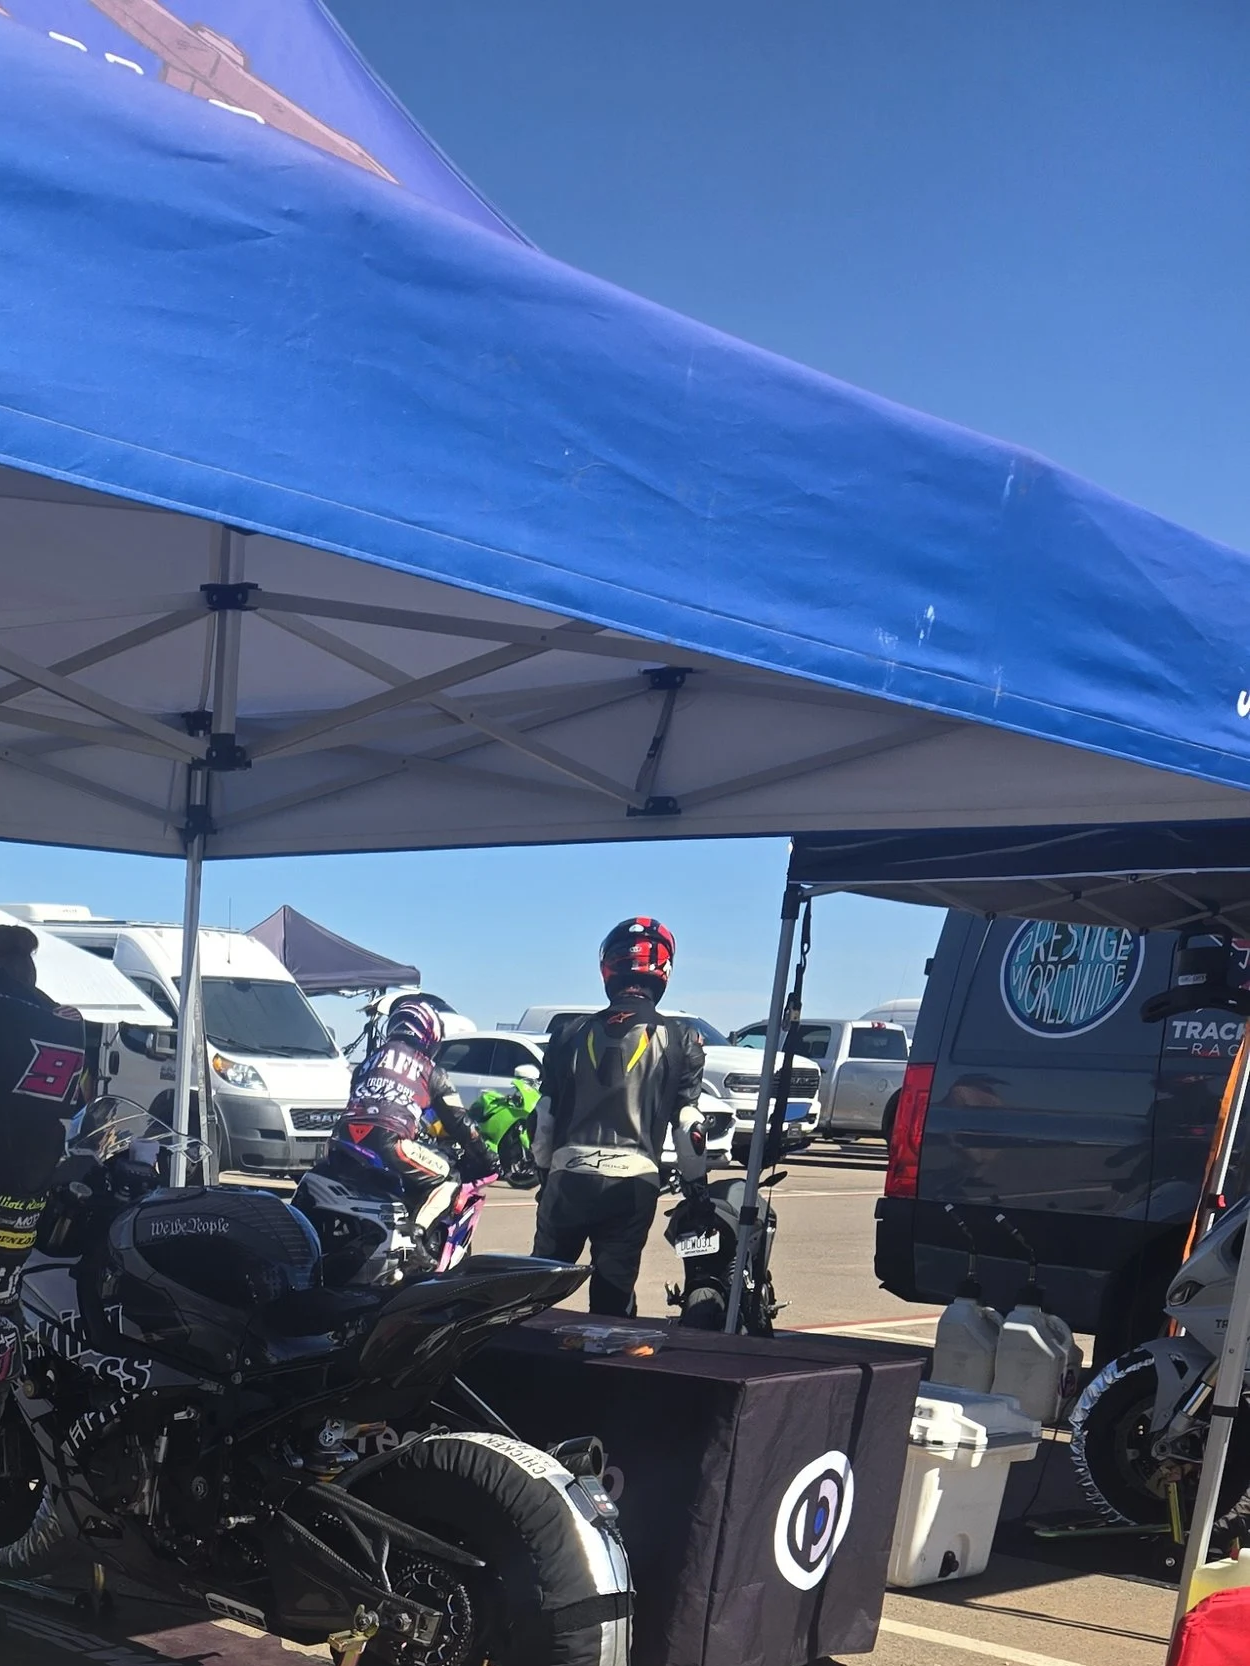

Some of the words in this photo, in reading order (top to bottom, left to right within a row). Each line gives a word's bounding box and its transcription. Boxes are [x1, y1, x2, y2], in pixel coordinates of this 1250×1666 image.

[1015, 920, 1133, 963] PRESTIGE
[1011, 963, 1127, 1025] WORLDWIDE
[482, 1436, 547, 1475] CHICKEN
